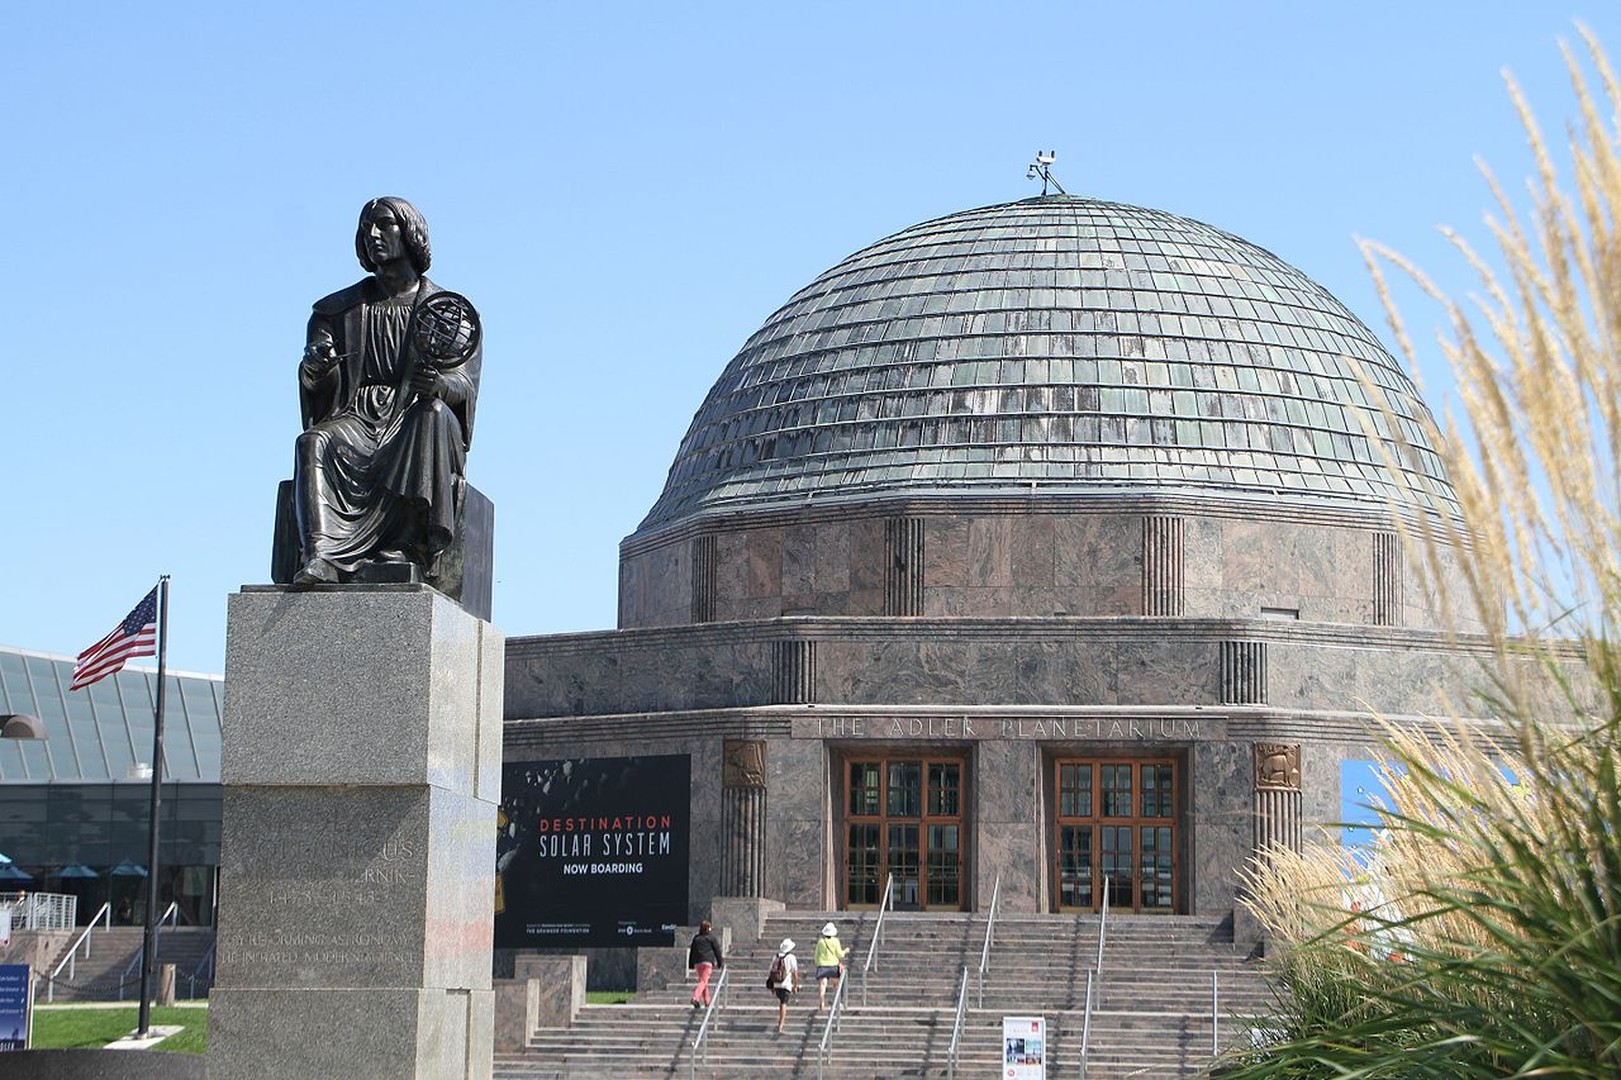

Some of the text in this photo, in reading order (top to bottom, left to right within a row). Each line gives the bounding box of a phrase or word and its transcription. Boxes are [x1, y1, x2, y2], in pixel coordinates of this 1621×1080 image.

[816, 717, 1200, 739] THE ADLER PLANETARIUM
[540, 816, 671, 832] DESTINATION
[540, 832, 670, 857] SOLAR SYSTEM
[563, 863, 643, 875] NOW BOARDING
